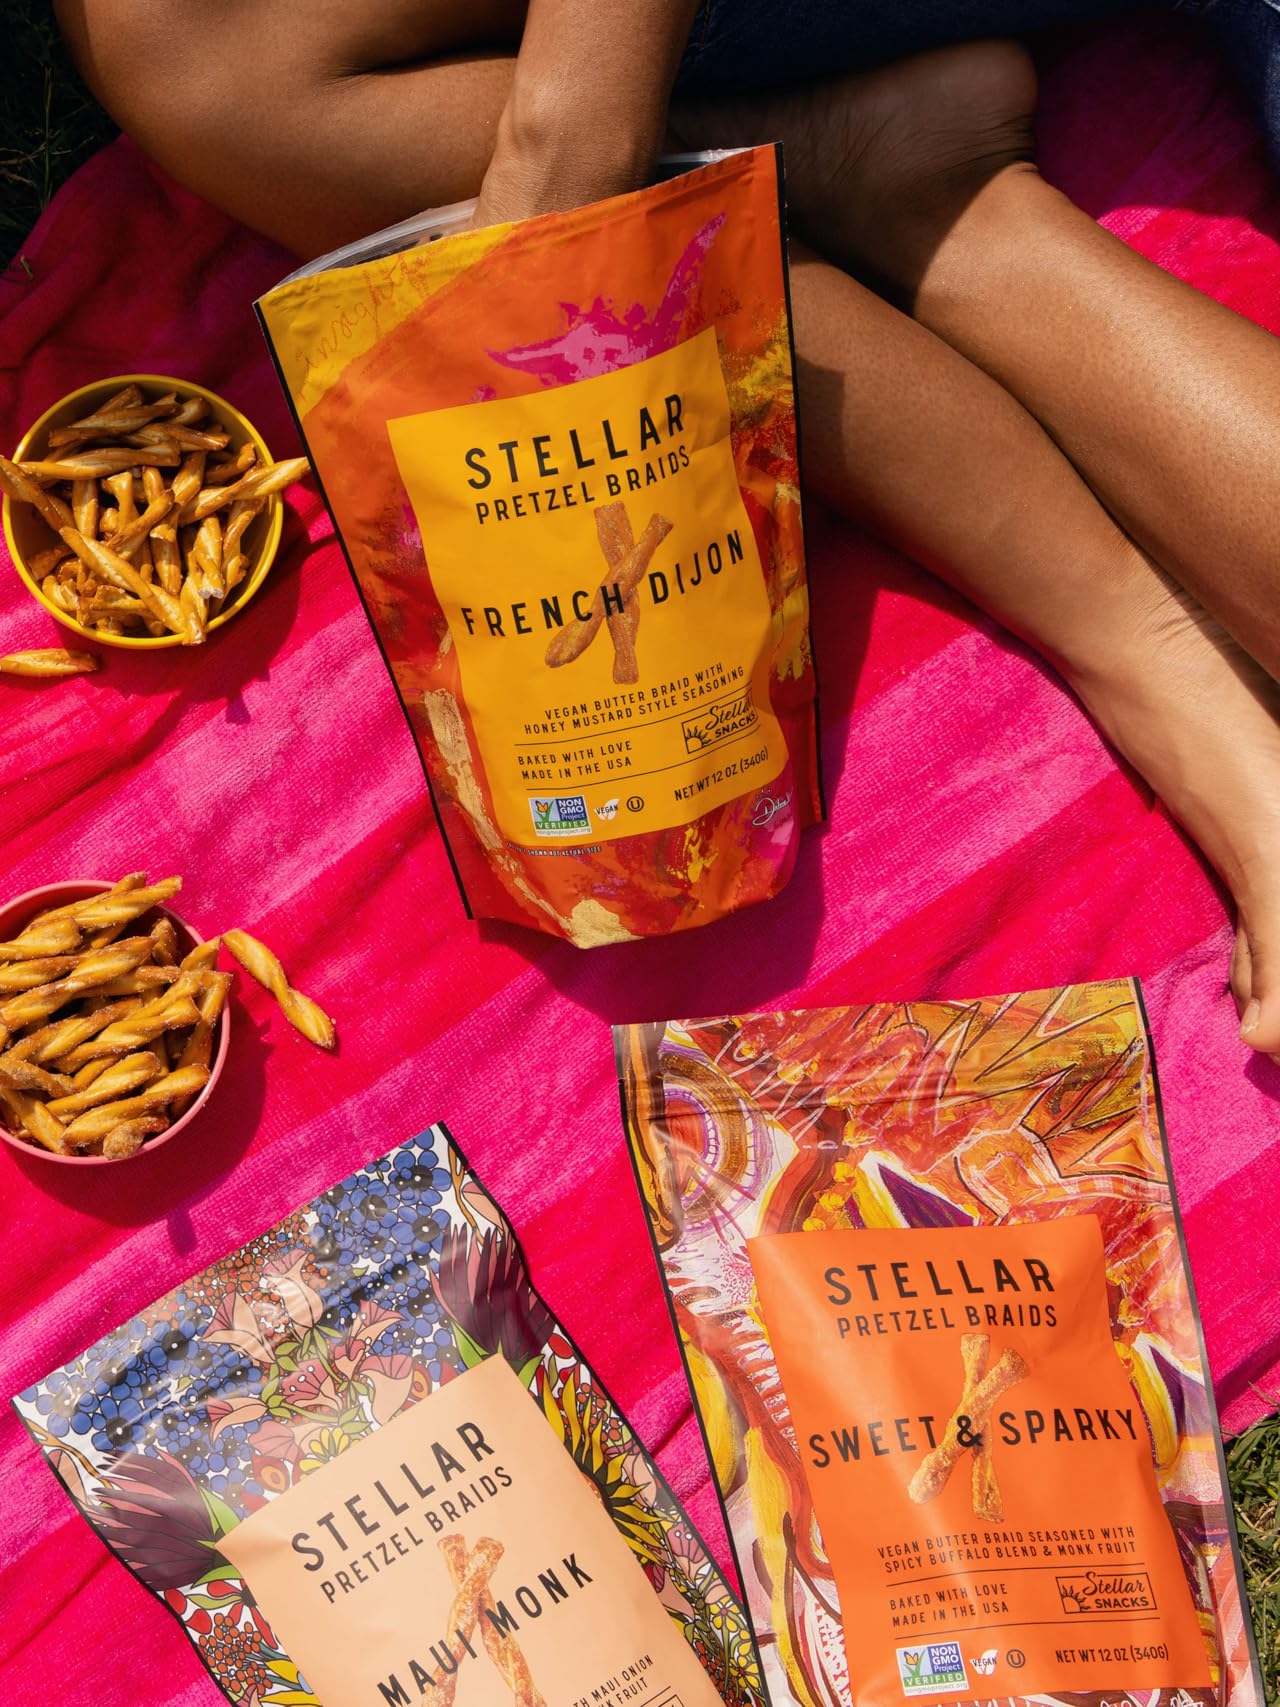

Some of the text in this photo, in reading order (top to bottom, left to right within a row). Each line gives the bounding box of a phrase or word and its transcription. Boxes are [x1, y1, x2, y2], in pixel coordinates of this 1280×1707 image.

[465, 394, 684, 490] STELLAR
[476, 445, 690, 524] PRETZEL BRAIDS
[460, 529, 744, 637] FRENCH DIJON
[524, 666, 744, 735] HONEY MUSTARD STYLE SEASONING
[545, 663, 724, 720] VEGAN BUTTER BRAID WITH
[715, 712, 756, 738] SNACKS
[518, 741, 632, 766] BAKED WITH LOVE
[522, 756, 633, 780] MADE IN THE USA
[674, 745, 769, 801] NET WT 12 OZ (340G)
[558, 799, 582, 808] NON
[560, 805, 584, 814] GMO
[596, 804, 618, 815] VEGAN
[536, 820, 587, 829] VERIFIED
[561, 813, 585, 821] Project
[824, 1258, 1055, 1306] STELLAR
[837, 1304, 1057, 1339] PRETZEL BRAIDS
[808, 1408, 1137, 1468] SWEET & SPARKY
[291, 1422, 495, 1572] STELLAR
[319, 1466, 513, 1604] PRETZEL BRAIDS
[878, 1526, 1135, 1559] VEGAN BUTTER BRAID SEASONED WITH
[885, 1541, 1136, 1574] SPICY BUFFALO BLEND & MONK FRUIT
[1082, 1571, 1145, 1596] Stellar
[889, 1584, 1008, 1611] BAKED WITH LOVE
[1095, 1597, 1149, 1609] SNACKS
[892, 1601, 1009, 1627] MADE IN THE USA
[377, 1553, 593, 1707] MAUI MONK
[930, 1645, 957, 1657] NON
[932, 1654, 959, 1666] GMO
[972, 1657, 997, 1667] VEGAN
[1055, 1643, 1169, 1664] NET WT 12 OZ (340G)
[591, 1654, 654, 1702] MAUI ONION
[907, 1673, 963, 1686] VERIFIED
[934, 1664, 961, 1673] Project
[616, 1677, 648, 1705] FRUIT
